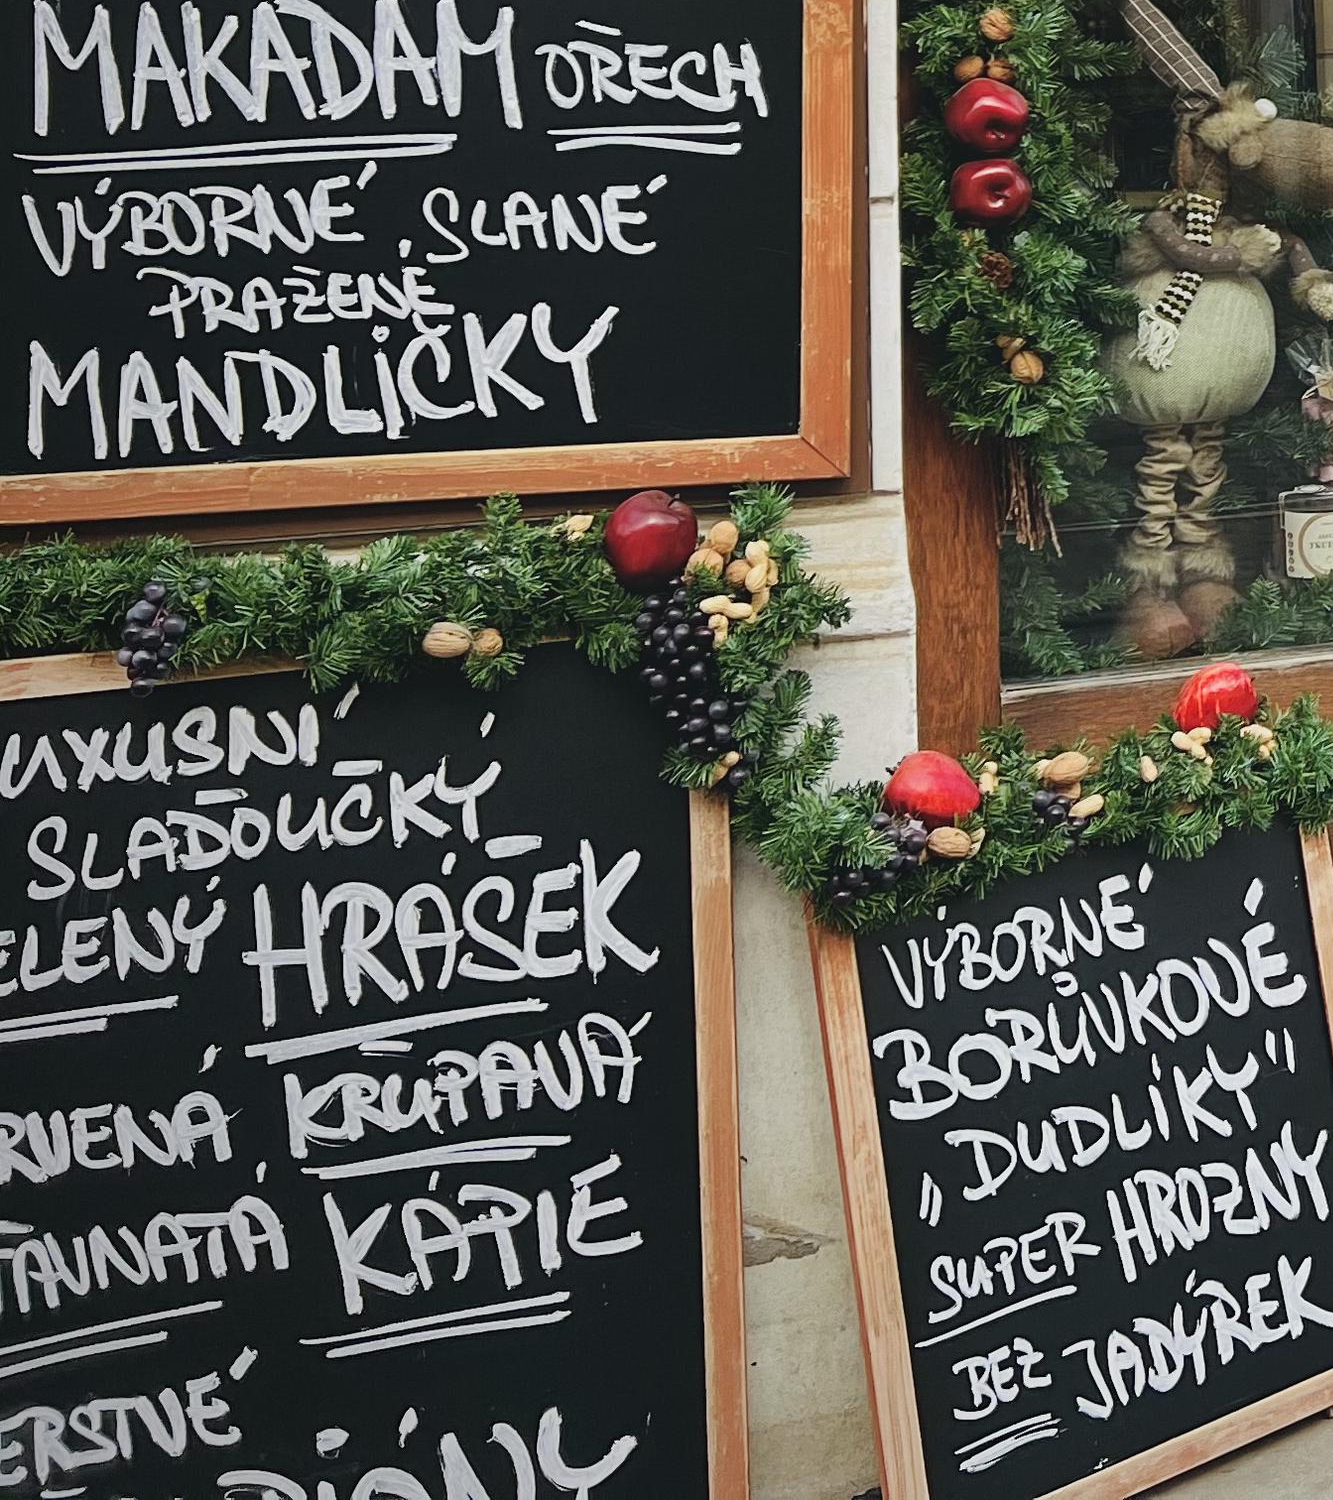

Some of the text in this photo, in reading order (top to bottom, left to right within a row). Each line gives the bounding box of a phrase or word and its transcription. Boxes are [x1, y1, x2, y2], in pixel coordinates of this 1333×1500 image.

[536, 21, 768, 117] OŘECH
[22, 161, 378, 277] VÝBORNÉ
[0, 683, 359, 799] UXUSNÍ
[0, 836, 660, 1029] ELENÝ HRÁŠEK
[881, 863, 1153, 1009] VÝBORNÉ
[928, 1122, 1329, 1324] SUPER HROZNY
[0, 1346, 258, 1485] ERSTVÉ
[953, 1337, 1052, 1421] BEZ
